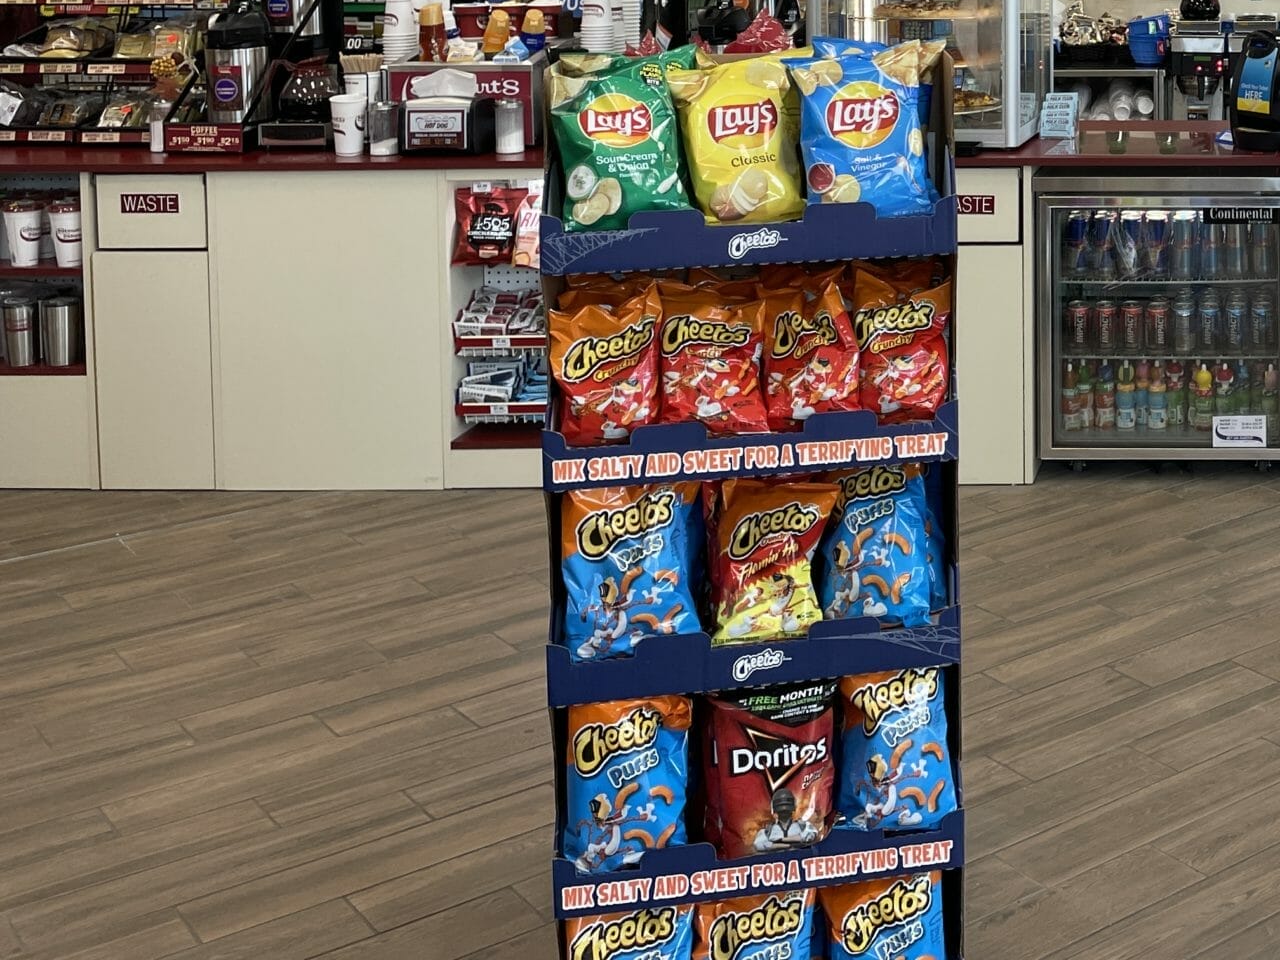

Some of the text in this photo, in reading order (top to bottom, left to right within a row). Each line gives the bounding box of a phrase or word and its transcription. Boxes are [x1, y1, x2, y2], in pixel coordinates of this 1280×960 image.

[424, 121, 436, 129] HOT
[587, 109, 648, 137] Lay's
[713, 102, 774, 137] Lay's
[834, 94, 896, 131] Lay's
[191, 126, 218, 134] COFFEE
[596, 152, 658, 165] Sour Cream
[608, 161, 650, 173] & Onion
[731, 153, 777, 168] Classic
[850, 162, 886, 173] Vinegar
[123, 195, 177, 212] WASTE
[957, 196, 994, 213] ASTE
[1209, 208, 1274, 220] Continental
[474, 217, 511, 231] 4505
[729, 228, 779, 259] Cheetos
[661, 316, 750, 357] Cheetos
[854, 301, 935, 347] Cheetos
[1076, 313, 1084, 344] IMPACT
[1157, 314, 1165, 345] IMPACT
[1204, 315, 1212, 345] IMPACT
[564, 321, 654, 382] Cheetos
[869, 332, 914, 353] Crunchy
[594, 356, 639, 381] Crunchy
[553, 432, 948, 482] MIX SALTY AND SWEET FOR A TERRIFYING TREAT
[578, 494, 672, 559] Cheetos
[729, 504, 818, 559] Cheetos
[738, 550, 781, 580] Flamin'
[733, 648, 783, 681] Cheetos
[748, 685, 824, 706] FREE MONTH
[574, 708, 660, 775] Cheetos
[732, 737, 827, 774] Doritos
[562, 840, 953, 909] MIX SALTY AND SWEET FOR A TERRIFYING TREAT
[710, 897, 801, 960] Cheetos
[842, 878, 931, 953] Cheetos
[571, 908, 675, 960] Cheetos
